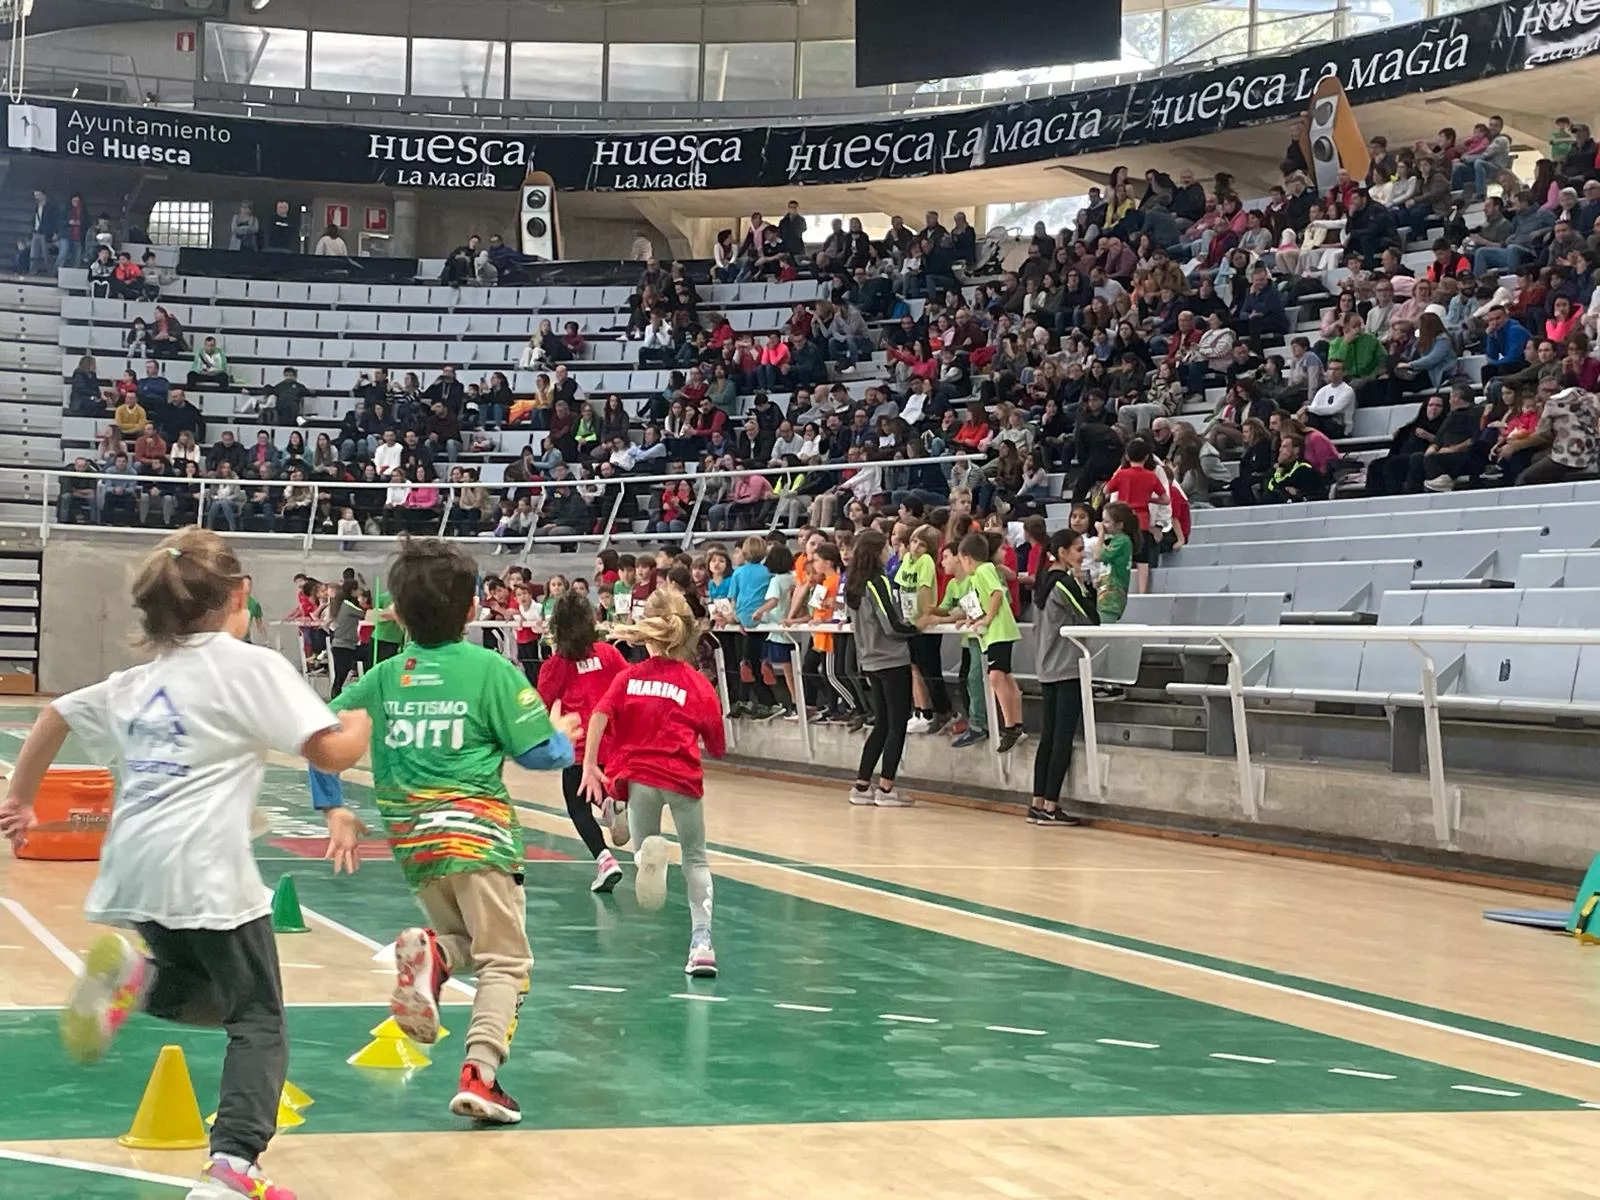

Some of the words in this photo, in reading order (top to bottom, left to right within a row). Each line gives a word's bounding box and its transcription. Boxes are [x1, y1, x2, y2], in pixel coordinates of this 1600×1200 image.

[1145, 73, 1286, 129] Huesca
[67, 110, 231, 143] Ayuntamiento
[67, 135, 94, 156] de
[103, 137, 191, 165] Huesca
[368, 134, 525, 166] Huesca
[593, 134, 742, 166] Huesca
[786, 131, 934, 172] Huesca
[397, 169, 422, 185] La
[614, 173, 638, 189] La
[626, 679, 687, 707] MARINA
